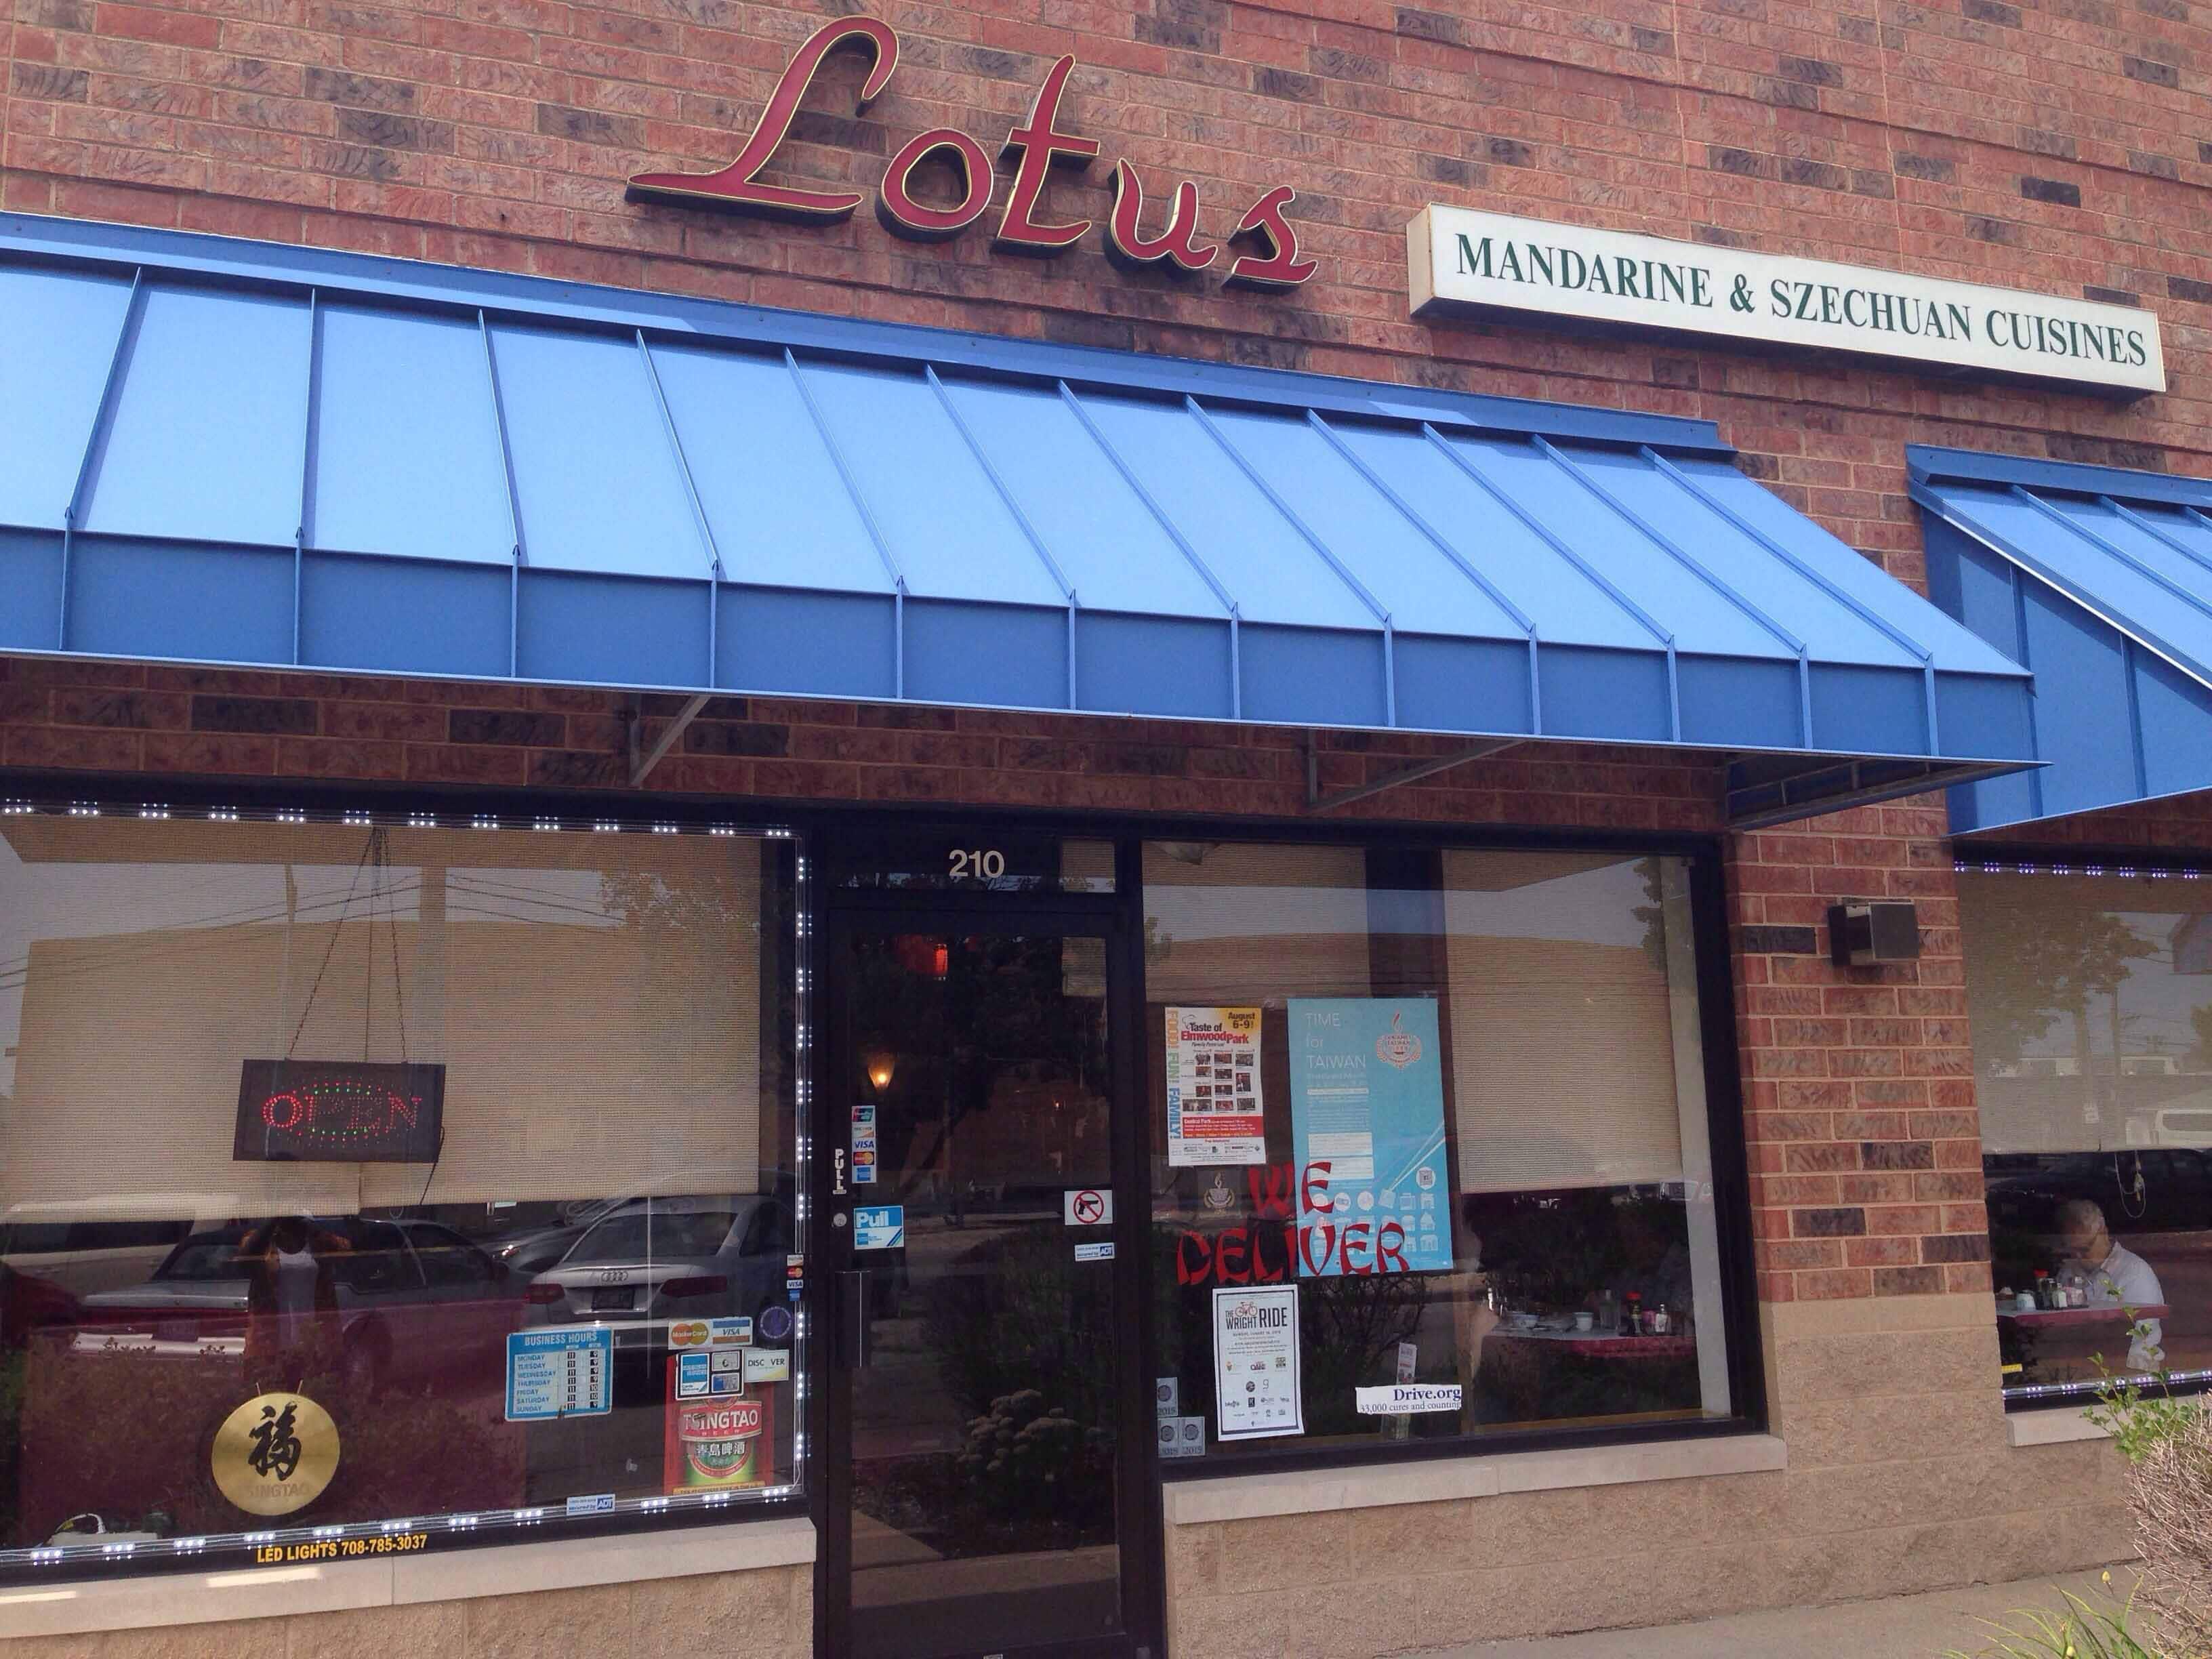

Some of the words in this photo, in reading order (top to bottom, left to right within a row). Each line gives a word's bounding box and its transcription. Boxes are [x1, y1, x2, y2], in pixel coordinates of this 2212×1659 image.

[625, 15, 1319, 290] Lotus
[1455, 232, 1713, 308] MANDARINE
[1729, 273, 1756, 313] &
[1770, 278, 1972, 343] SZECHUAN
[1985, 307, 2147, 368] CUISINES
[949, 849, 1005, 878] 210
[1228, 1012, 1256, 1021] August
[1305, 1012, 1341, 1027] TIME
[1189, 1022, 1213, 1032] Taste
[1214, 1023, 1223, 1031] of
[1181, 1030, 1227, 1042] Elmwood
[1227, 1033, 1250, 1044] Park
[1306, 1054, 1366, 1069] TAIWAN
[262, 1094, 423, 1129] OPEN
[1168, 1088, 1181, 1139] FAMILY!
[855, 1140, 874, 1149] VISA
[834, 1148, 844, 1190] PULL
[1247, 1160, 1335, 1216] WE
[856, 1210, 889, 1229] Pull
[1100, 1246, 1112, 1255] ADT
[1176, 1221, 1410, 1286] DELIVER
[1225, 1310, 1233, 1318] THE
[1225, 1316, 1257, 1330] WRIGHT
[1258, 1307, 1288, 1328] RIDE
[525, 1334, 567, 1346] BUSINESS
[568, 1332, 597, 1344] HOURS
[722, 1328, 741, 1336] VISA
[747, 1358, 785, 1367] DISCVER
[1393, 1387, 1462, 1402] Drive.org
[1389, 1403, 1409, 1411] cures
[1411, 1401, 1425, 1410] and
[1427, 1401, 1461, 1410] counting
[683, 1409, 758, 1430] TSINGTAO
[241, 1482, 310, 1498] SINGTAO
[597, 1499, 613, 1509] ADT
[257, 1547, 283, 1563] LED
[287, 1542, 337, 1560] LIGHTS
[340, 1534, 428, 1556] 708-785-3037
